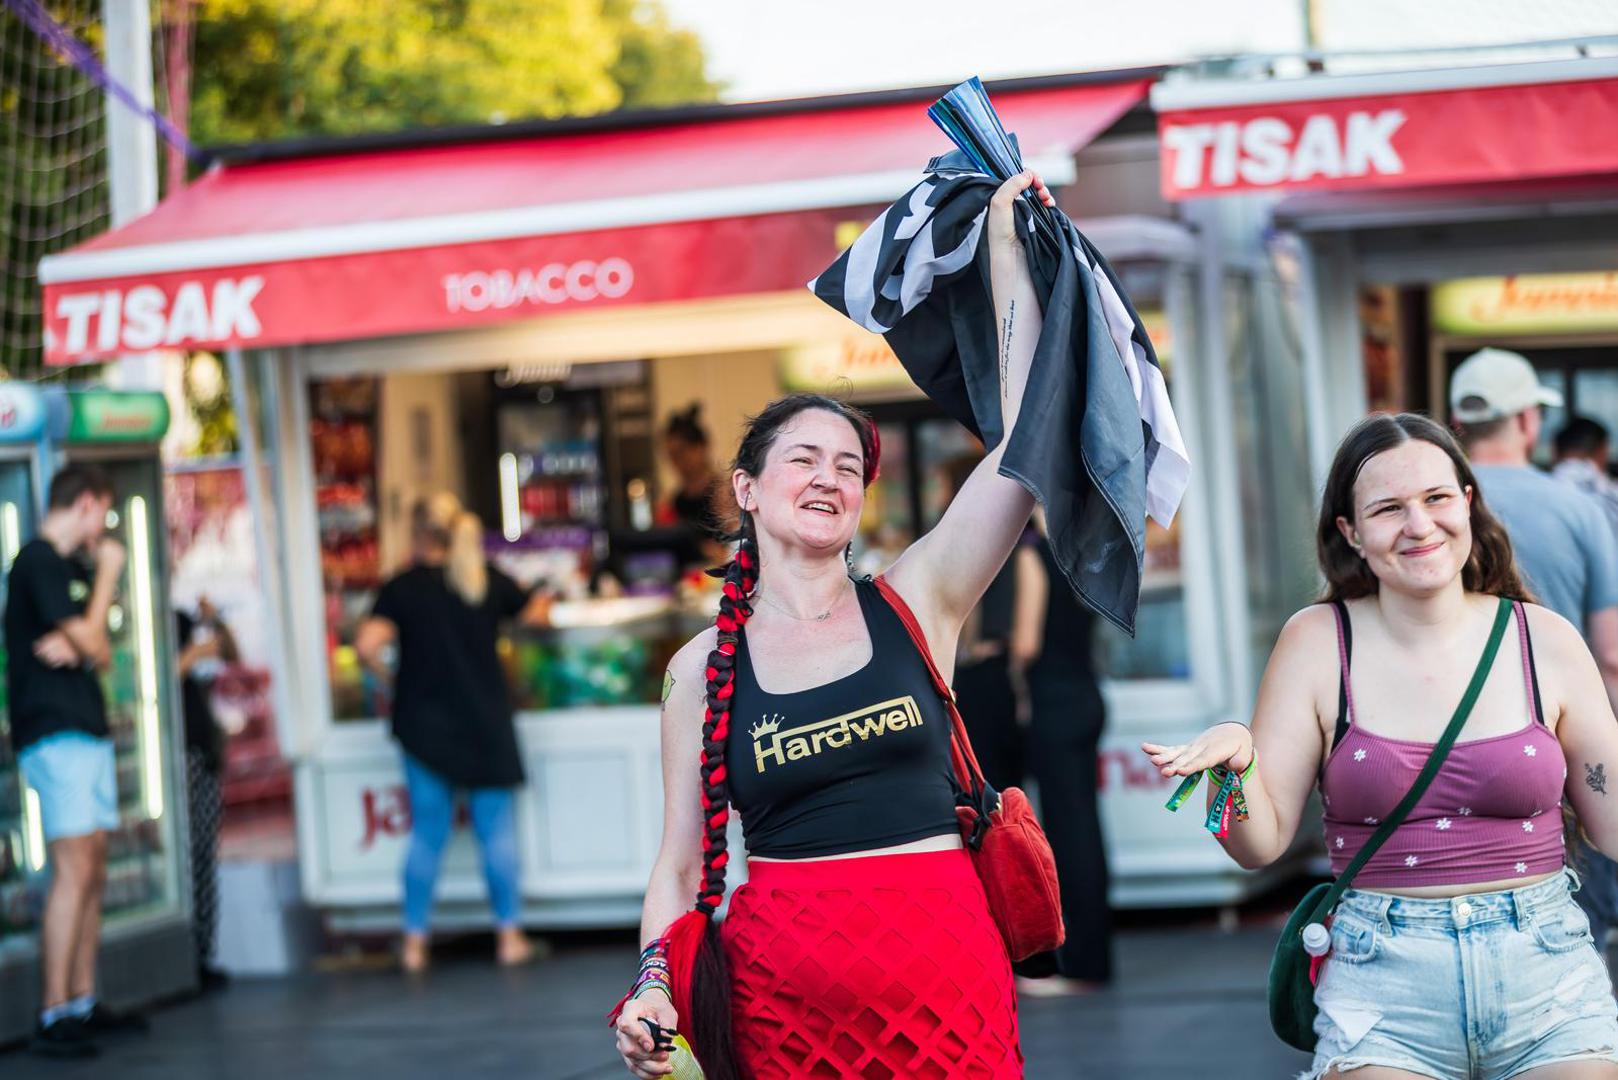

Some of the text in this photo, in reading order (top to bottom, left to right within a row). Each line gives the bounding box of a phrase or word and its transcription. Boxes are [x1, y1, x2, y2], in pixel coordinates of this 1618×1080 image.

[1163, 109, 1407, 188] TISAK
[57, 275, 264, 354] TISAK
[442, 257, 634, 313] TOBACCO
[753, 695, 923, 774] Hardwell
